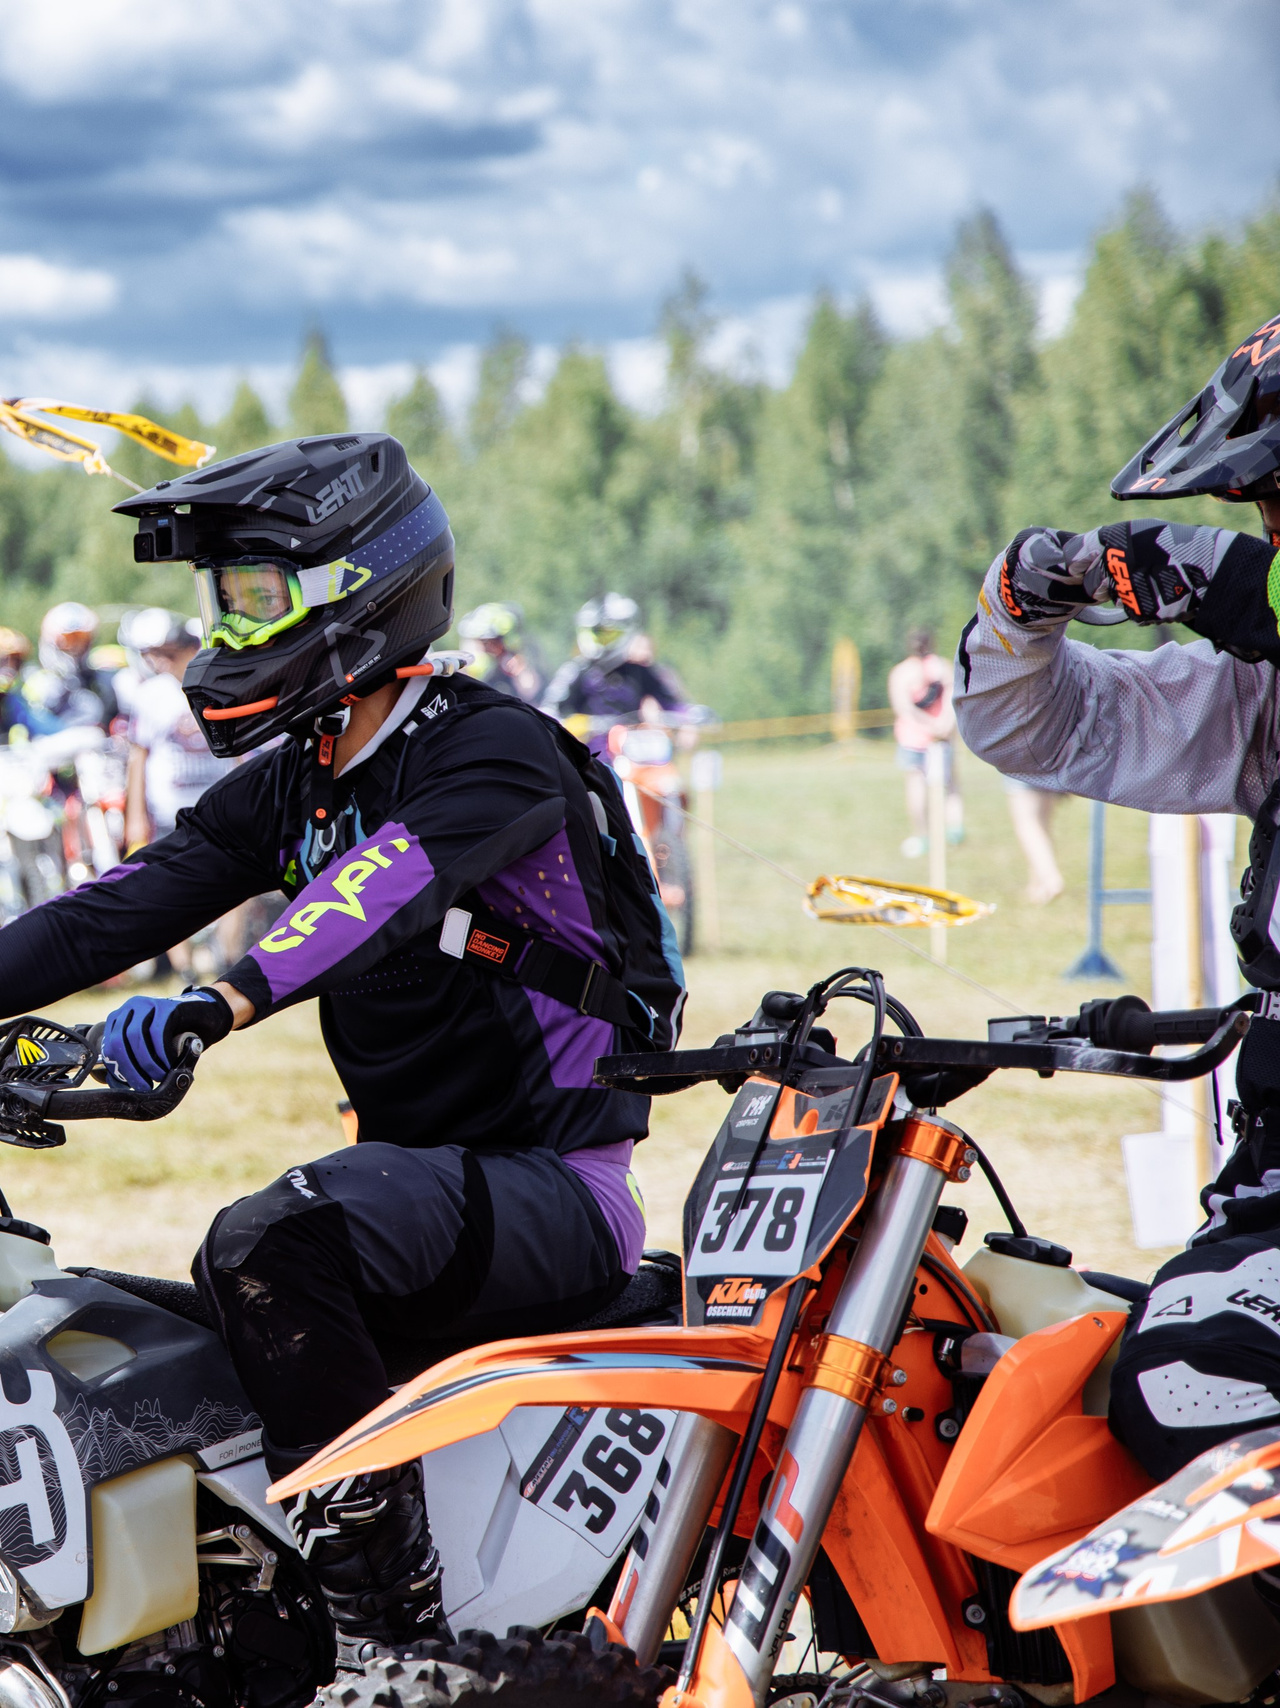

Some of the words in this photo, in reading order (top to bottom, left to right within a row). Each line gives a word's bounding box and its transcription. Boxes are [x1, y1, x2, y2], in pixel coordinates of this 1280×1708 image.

[474, 932, 487, 941] NO
[469, 943, 502, 959] MONKEY
[471, 938, 505, 955] DANCING
[700, 1186, 805, 1254] 378
[706, 1277, 764, 1304] KTM
[743, 1288, 767, 1300] CLUB
[706, 1305, 753, 1317] OSECHENKI
[219, 1449, 234, 1461] FOR
[552, 1407, 666, 1534] 368
[769, 1607, 793, 1649] XPLOR
